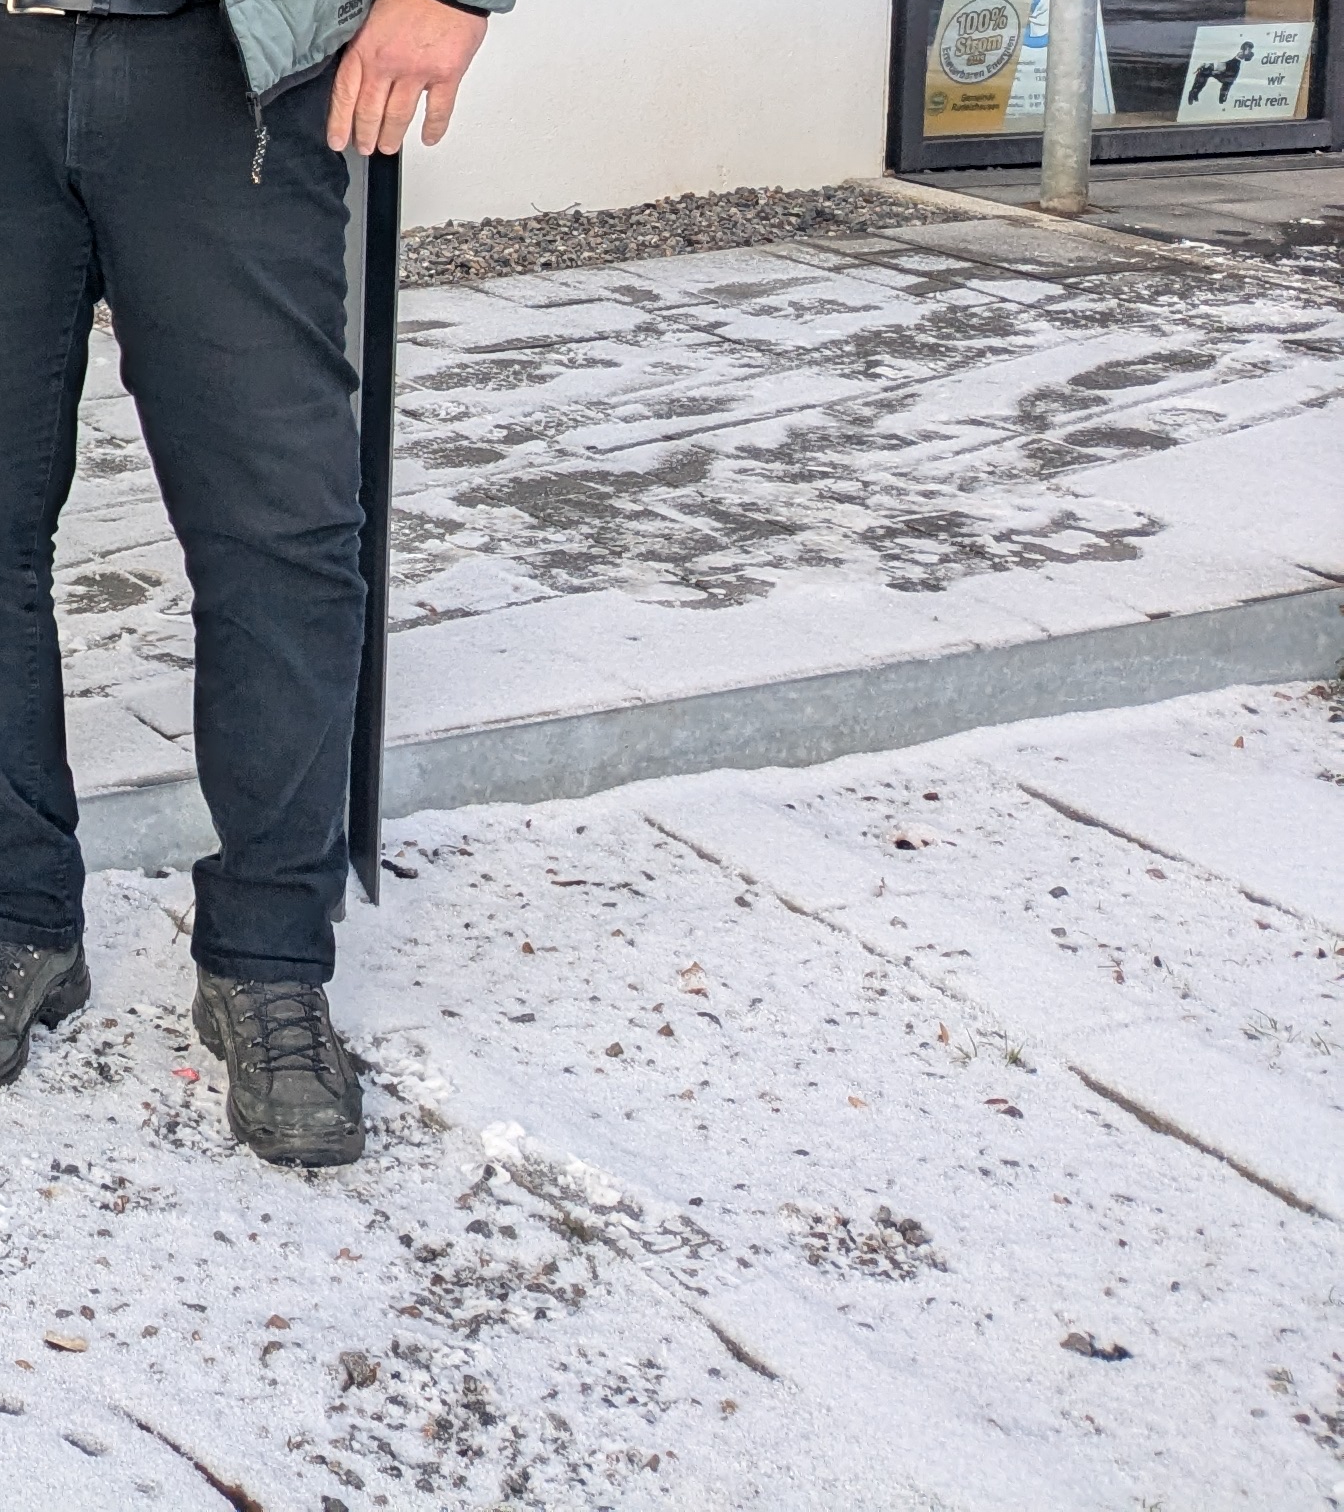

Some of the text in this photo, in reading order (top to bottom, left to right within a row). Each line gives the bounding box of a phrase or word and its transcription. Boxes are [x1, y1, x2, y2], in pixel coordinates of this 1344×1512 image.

[957, 6, 1008, 35] 100%
[1273, 31, 1298, 43] Hier
[955, 34, 1003, 57] Strom
[1261, 52, 1299, 65] dürfen
[1268, 73, 1285, 85] wir
[1234, 94, 1289, 110] nicht rein.
